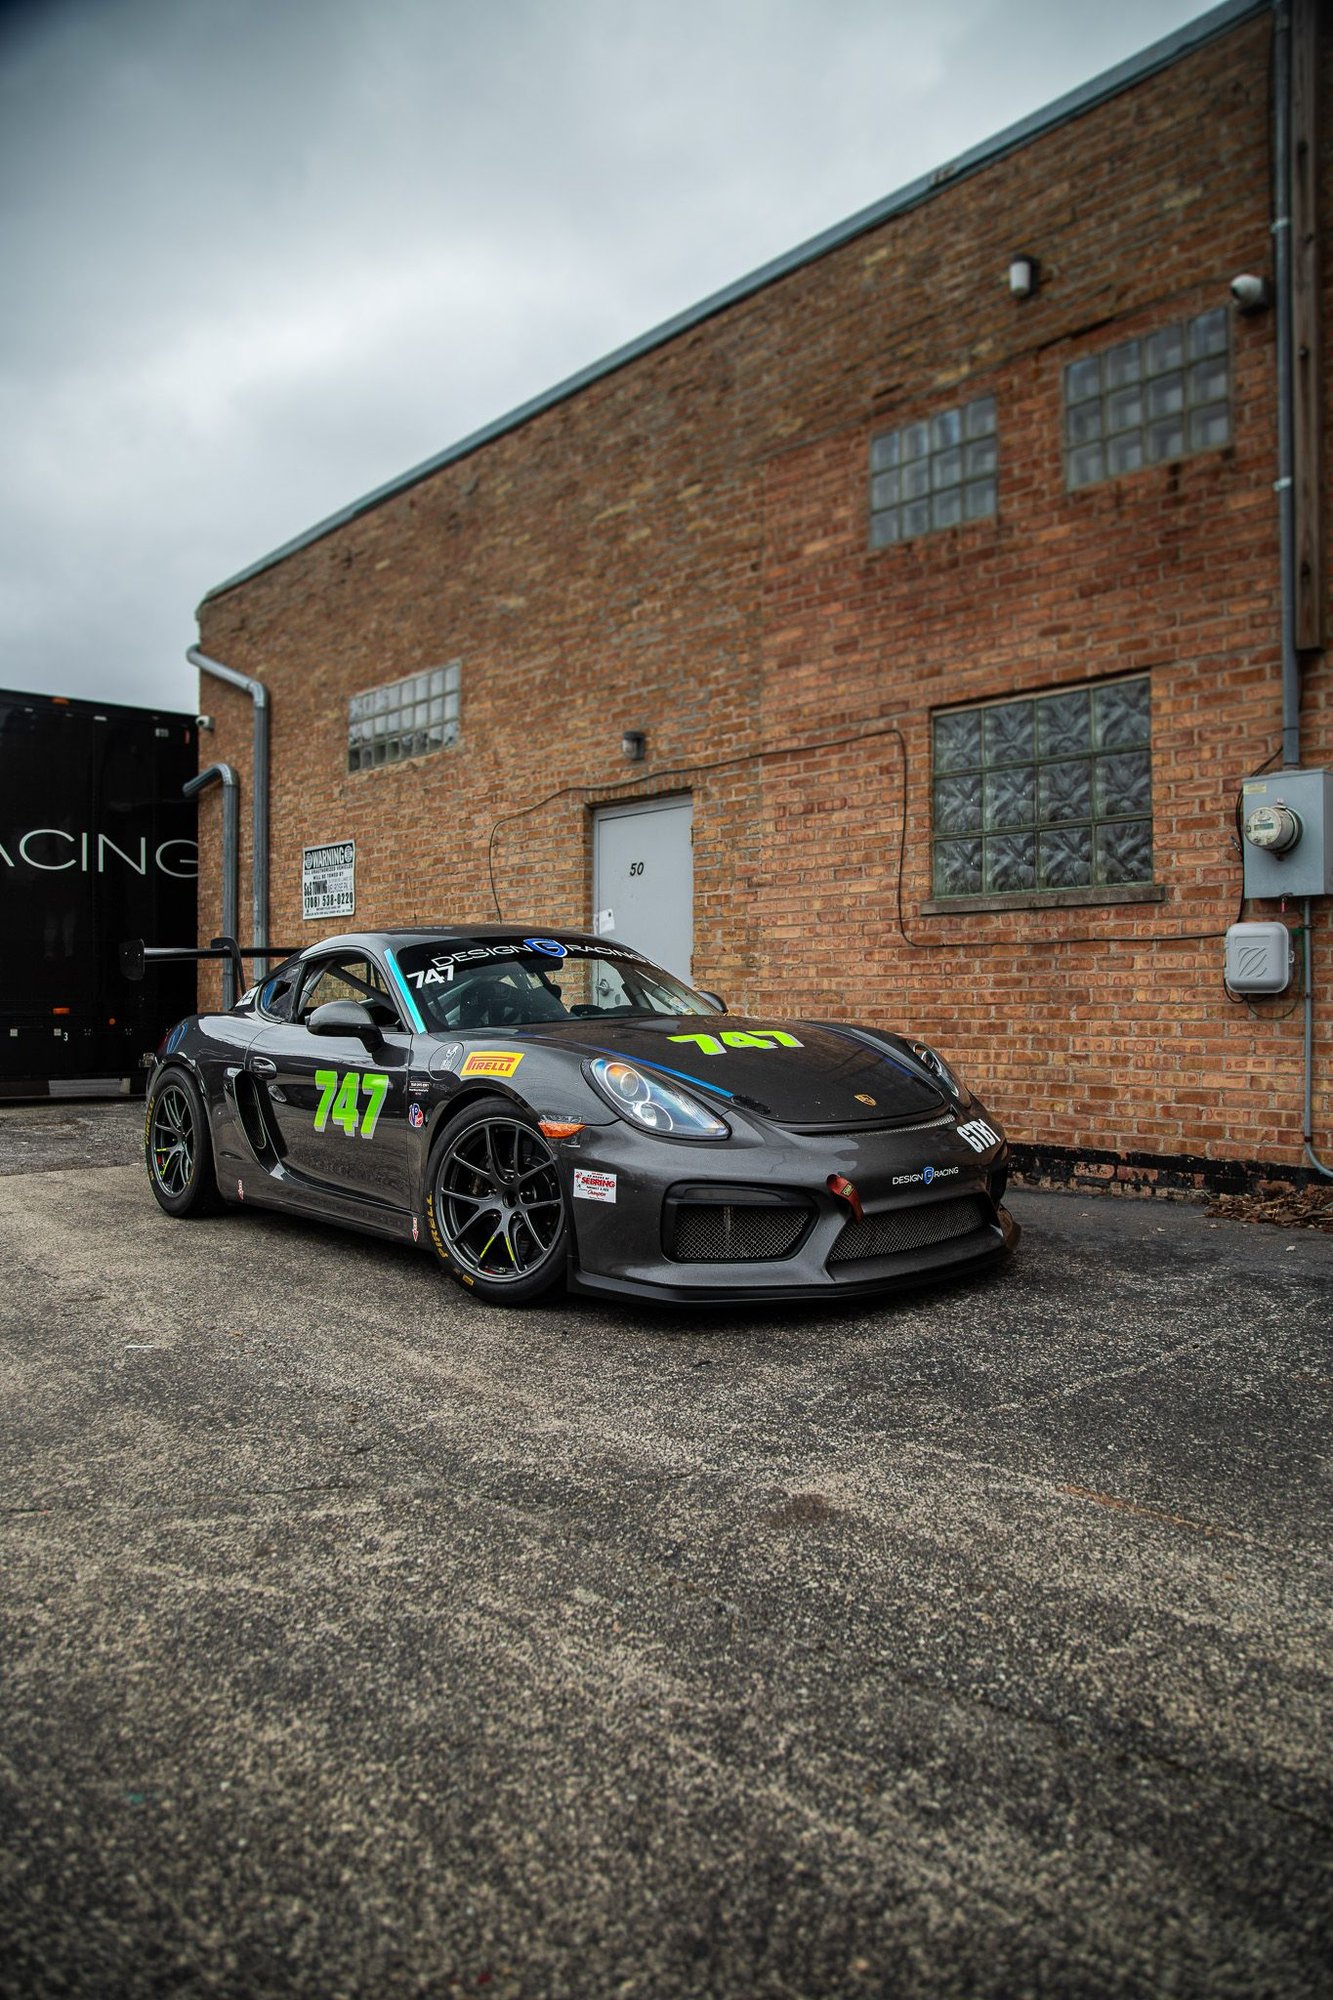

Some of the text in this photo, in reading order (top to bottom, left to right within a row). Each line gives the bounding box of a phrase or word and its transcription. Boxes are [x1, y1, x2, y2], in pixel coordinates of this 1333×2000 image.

[0, 829, 198, 878] CING
[312, 847, 344, 868] WARNING
[629, 862, 645, 876] 50
[431, 945, 533, 967] DESIGN
[565, 944, 648, 963] RACING
[406, 965, 455, 989] 747
[63, 1032, 69, 1041] 3
[666, 1030, 805, 1056] 747
[466, 1056, 516, 1072] PIRELLI
[314, 1070, 389, 1139] 747
[957, 1118, 1001, 1153] GTB1
[582, 1176, 615, 1188] SEBRING
[892, 1173, 924, 1185] DESIGN
[934, 1167, 959, 1178] RACING
